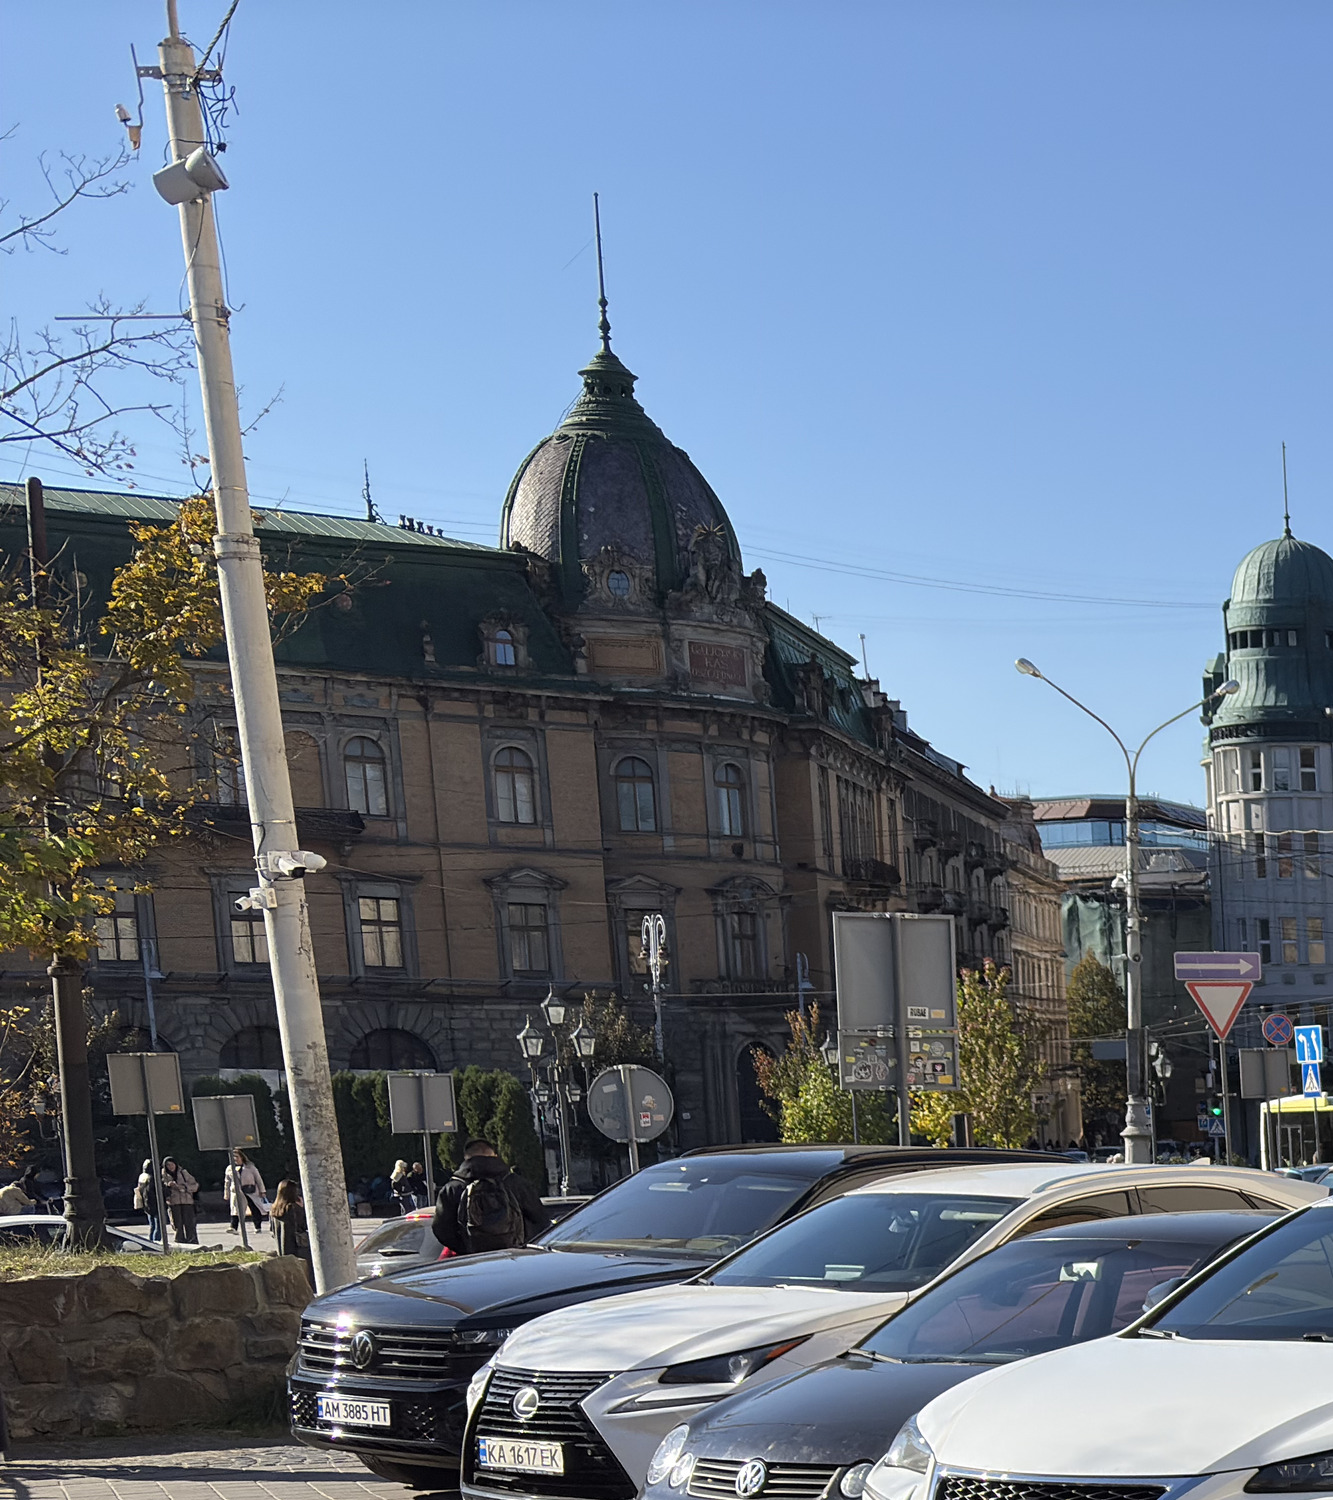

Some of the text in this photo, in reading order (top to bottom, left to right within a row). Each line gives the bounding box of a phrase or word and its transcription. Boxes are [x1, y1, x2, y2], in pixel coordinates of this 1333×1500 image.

[325, 1401, 389, 1422] AM 3885 HT
[487, 1444, 559, 1467] KA 1617 EK
